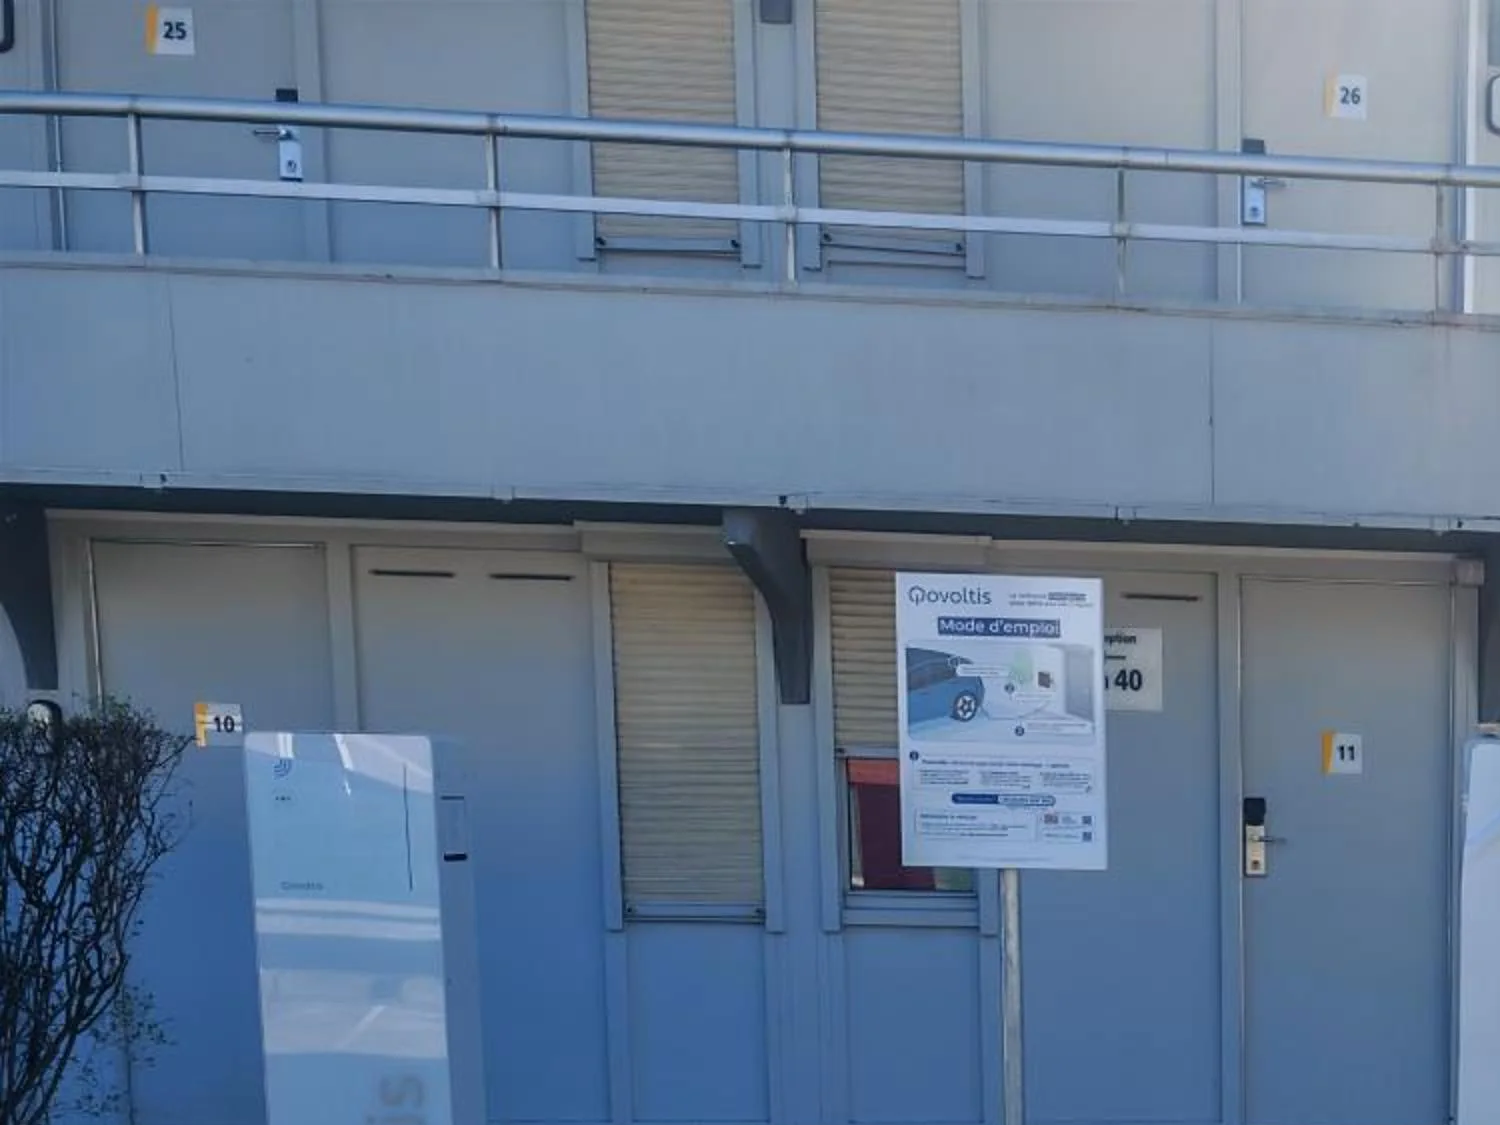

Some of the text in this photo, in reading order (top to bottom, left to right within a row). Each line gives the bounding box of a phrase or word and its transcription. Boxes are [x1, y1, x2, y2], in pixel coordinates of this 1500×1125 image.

[163, 21, 187, 40] 25
[1340, 86, 1361, 105] 26
[908, 585, 992, 606] Qovoltis
[940, 619, 1060, 637] Mode d'emploi
[1114, 669, 1142, 692] 40
[213, 715, 235, 733] 10
[1336, 745, 1355, 762] 11
